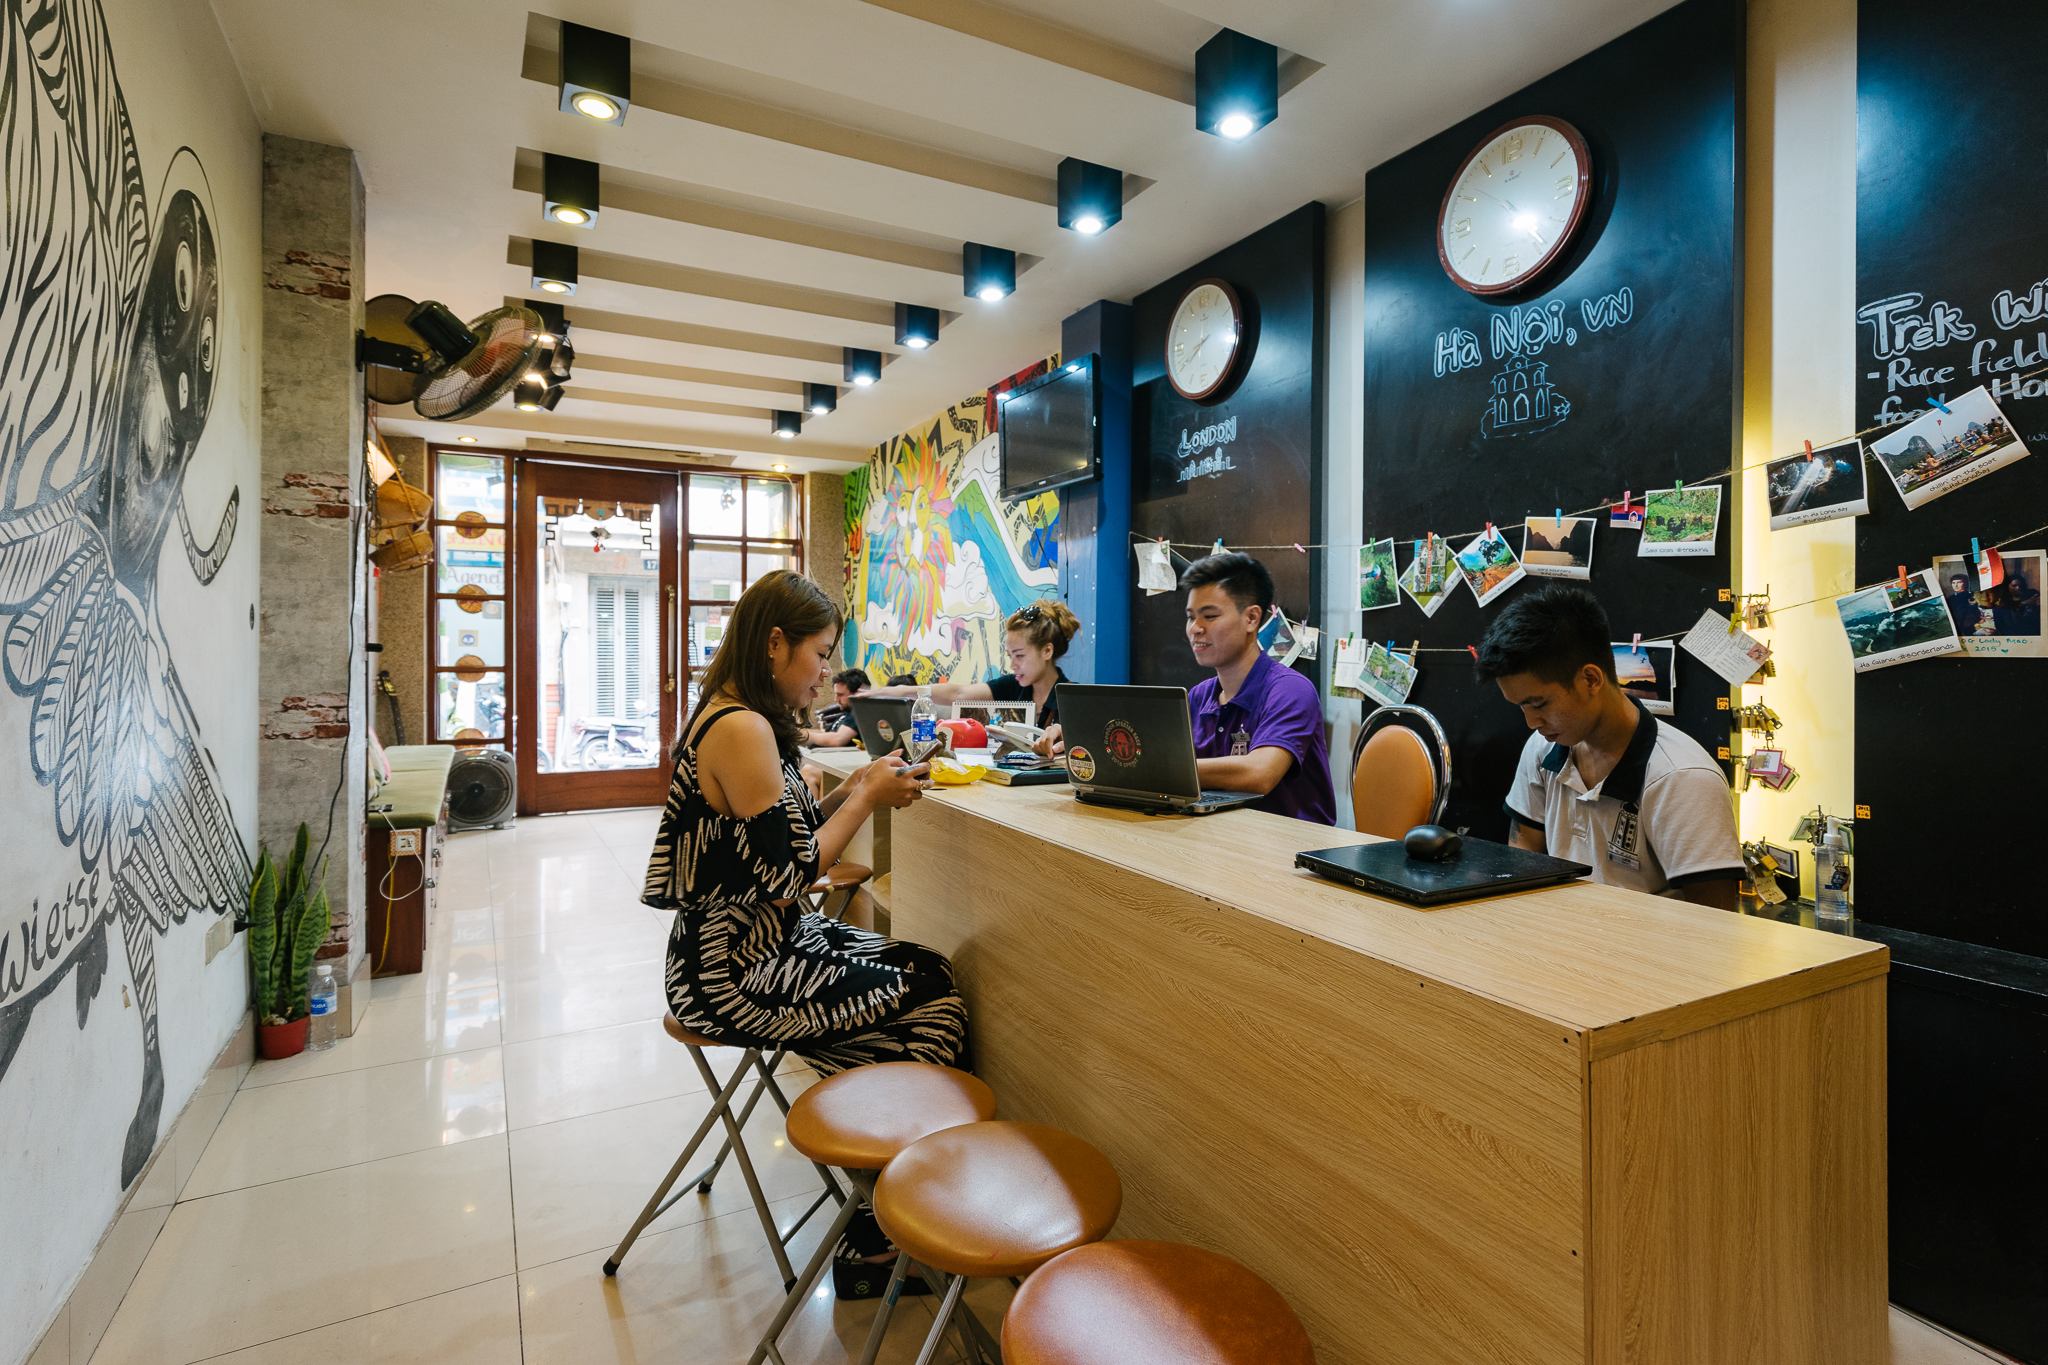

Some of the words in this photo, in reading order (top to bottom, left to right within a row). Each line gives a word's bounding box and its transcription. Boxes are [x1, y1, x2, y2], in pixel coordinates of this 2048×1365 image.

[1502, 139, 1523, 165] 12
[1581, 287, 1633, 332] VN
[1856, 292, 1976, 360] Trek
[1991, 372, 2048, 405] Ho
[1177, 415, 1237, 458] LONDON
[614, 557, 627, 570] 27
[646, 560, 657, 570] 17
